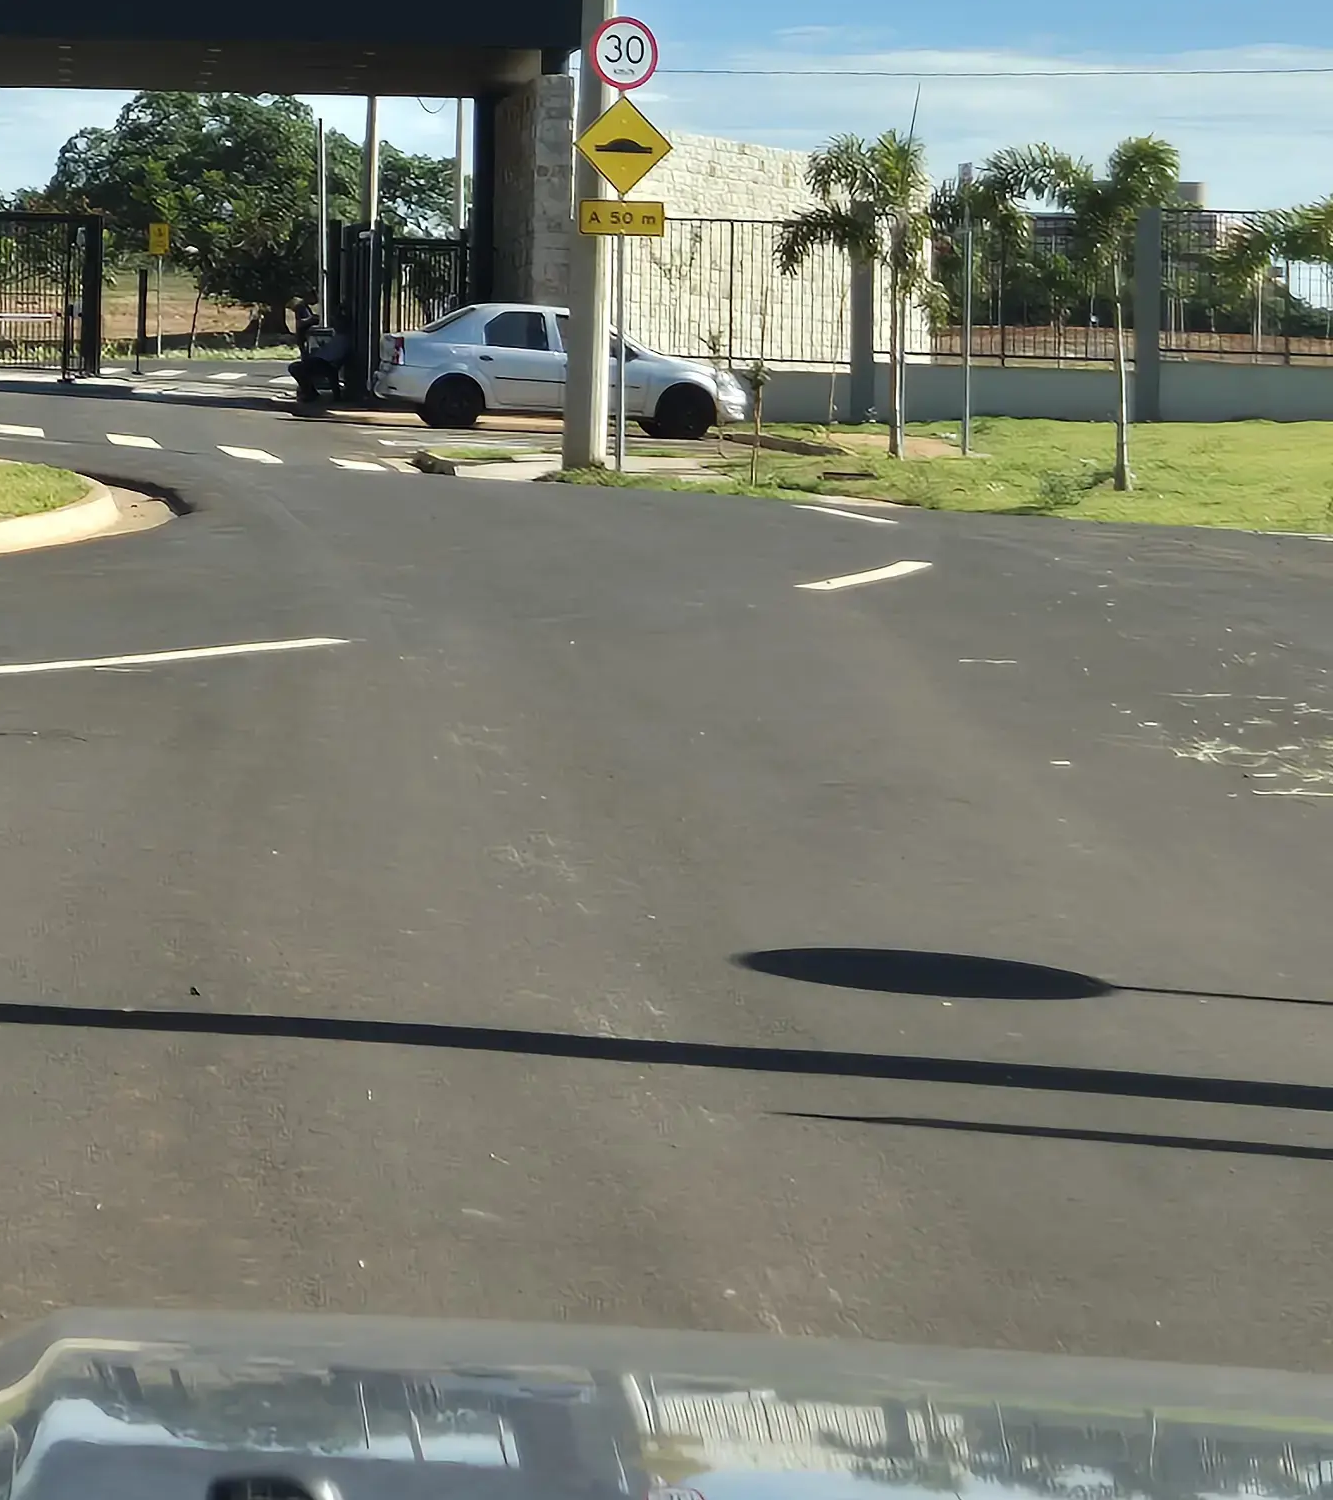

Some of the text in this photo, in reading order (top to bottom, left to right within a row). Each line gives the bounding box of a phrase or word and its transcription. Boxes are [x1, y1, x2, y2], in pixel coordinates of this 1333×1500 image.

[604, 34, 645, 64] 30
[588, 211, 656, 225] A 50 m
